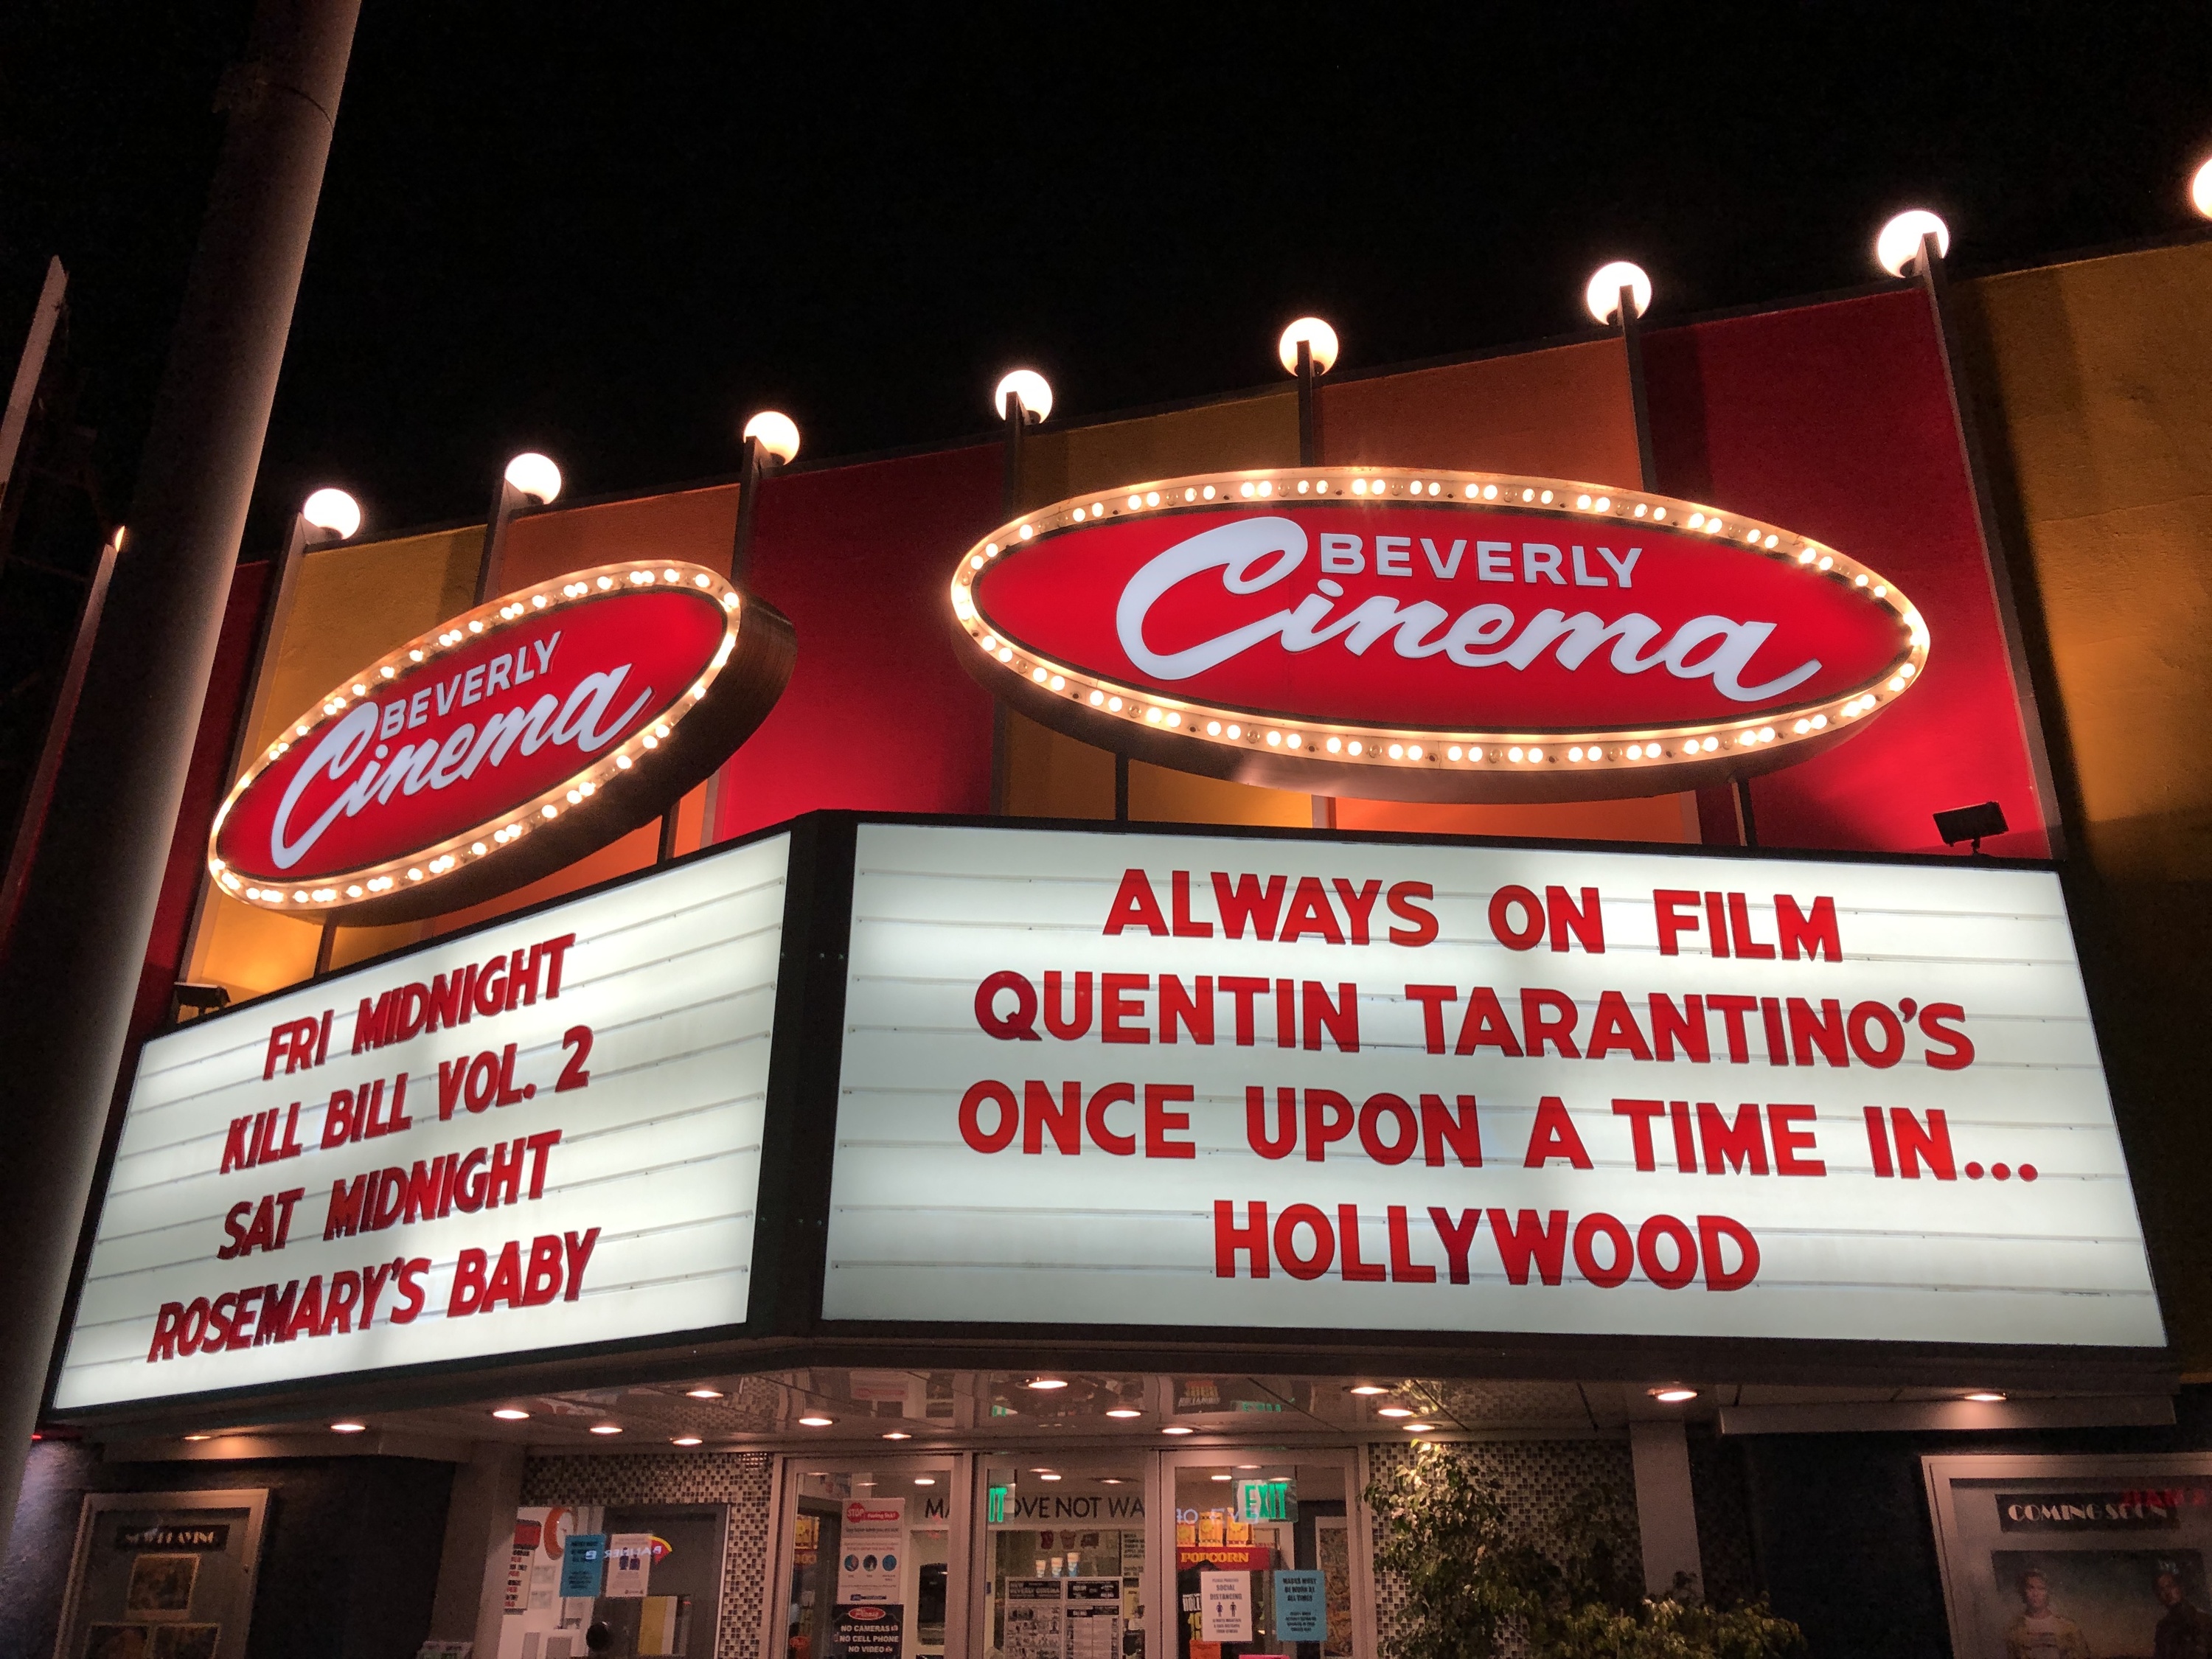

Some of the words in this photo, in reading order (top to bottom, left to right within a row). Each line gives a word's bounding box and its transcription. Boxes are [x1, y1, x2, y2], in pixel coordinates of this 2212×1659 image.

[1116, 516, 1823, 701] Cinema
[1321, 532, 1643, 589] BEVERLY
[380, 630, 561, 739] BEVERLY
[271, 663, 653, 869] Cinema
[1104, 869, 1438, 948] ALWAYS
[1488, 885, 1606, 953] ON
[1654, 888, 1843, 963] FILM
[264, 1008, 335, 1080] FRI
[351, 933, 576, 1054] MIDNIGHT
[975, 970, 1360, 1052] QUENTIN
[1405, 984, 1975, 1071] TARANTINO'S
[220, 1102, 302, 1174] KILL
[319, 1072, 413, 1150] BILL
[439, 1042, 536, 1121] VOL.
[554, 1025, 594, 1092] 2
[959, 1079, 1196, 1160] ONCE
[1246, 1086, 1482, 1167] UPON
[1524, 1095, 1593, 1170] A
[1611, 1098, 1827, 1178] TIME
[1863, 1106, 2039, 1183] IN...
[215, 1187, 305, 1260] SAT
[323, 1130, 563, 1241] MIDNIGHT
[1214, 1199, 1761, 1291] HOLLYWOOD
[147, 1256, 431, 1364] ROSEMARY'S
[447, 1227, 601, 1318] BABY
[1055, 1497, 1102, 1518] NOT
[1245, 1483, 1287, 1519] EXIT
[2008, 1503, 2100, 1522] COMING
[1180, 1552, 1249, 1563] POPCORN
